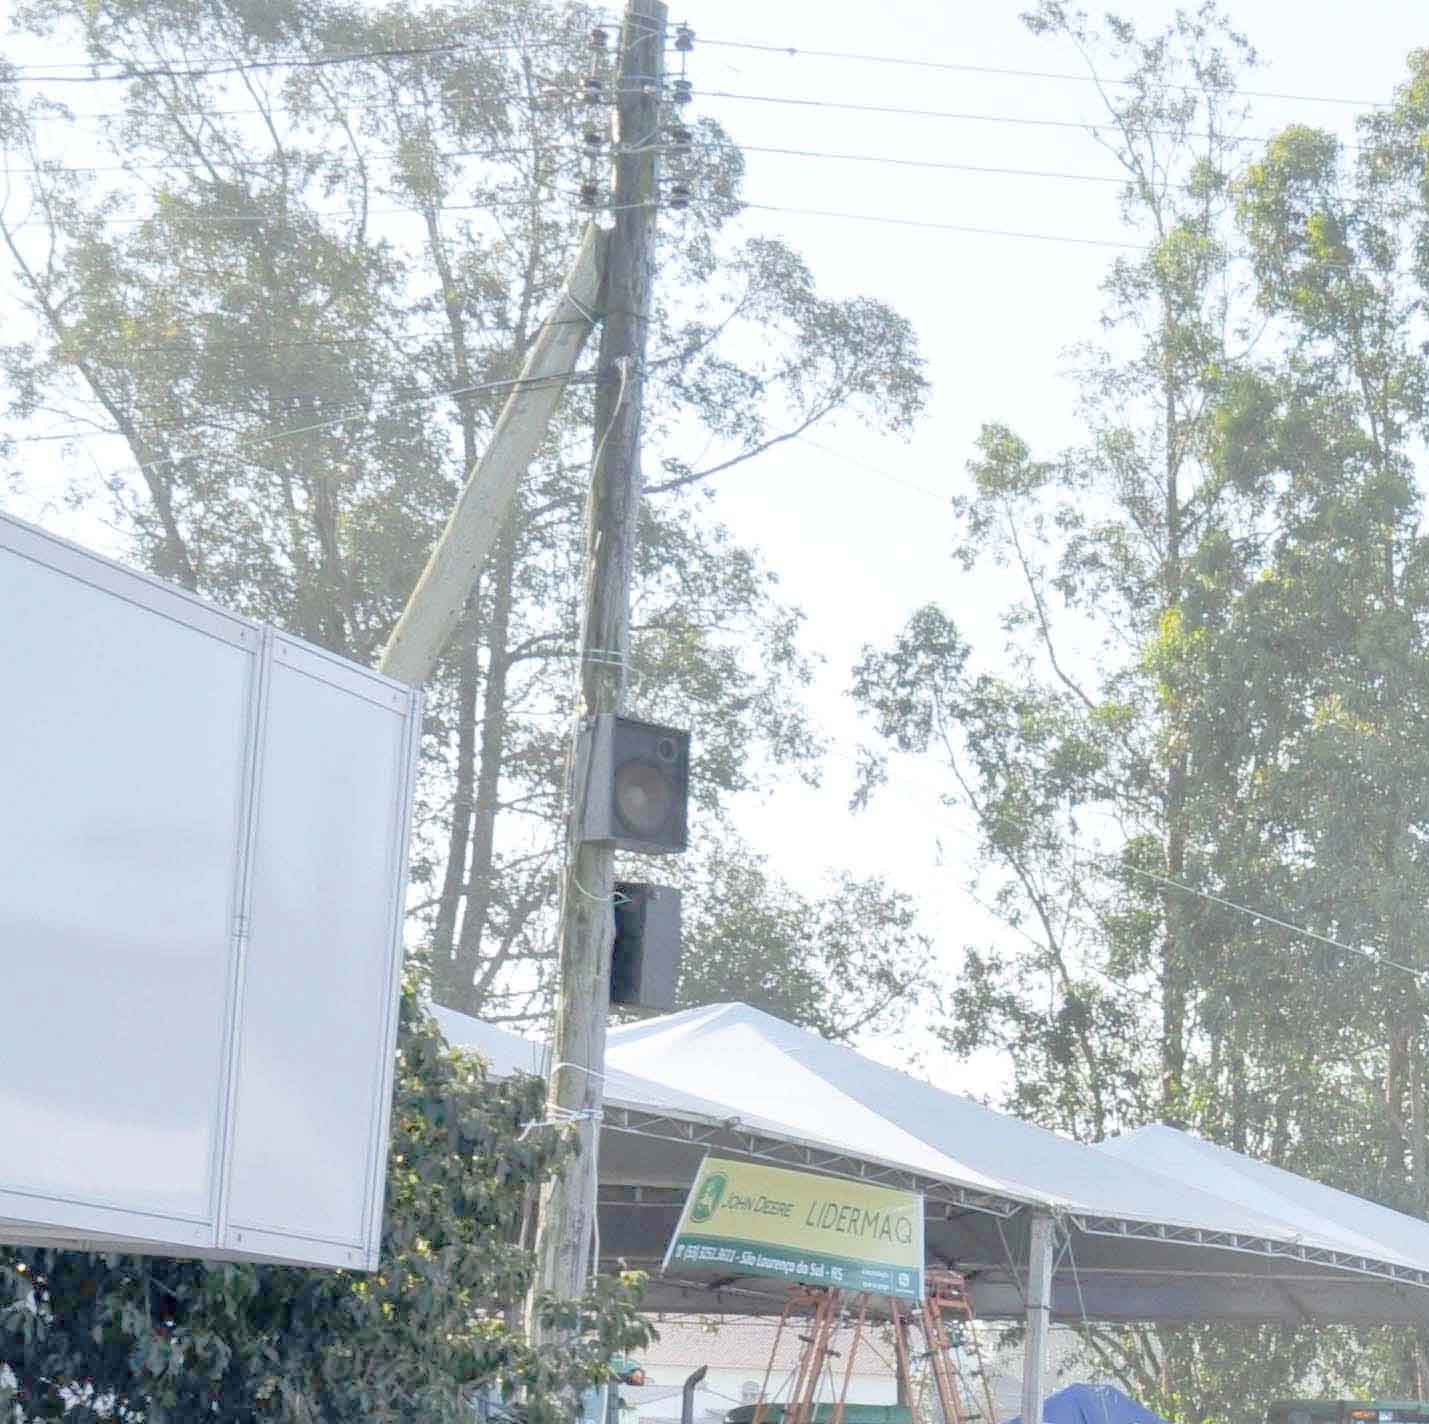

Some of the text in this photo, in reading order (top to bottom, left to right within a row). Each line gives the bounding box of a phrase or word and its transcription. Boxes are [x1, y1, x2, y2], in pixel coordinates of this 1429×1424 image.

[805, 1199, 912, 1244] LIDERMAQ
[756, 1253, 795, 1275] Lourenço
[796, 1259, 808, 1275] do
[809, 1262, 825, 1278] Sul
[830, 1266, 844, 1281] RS
